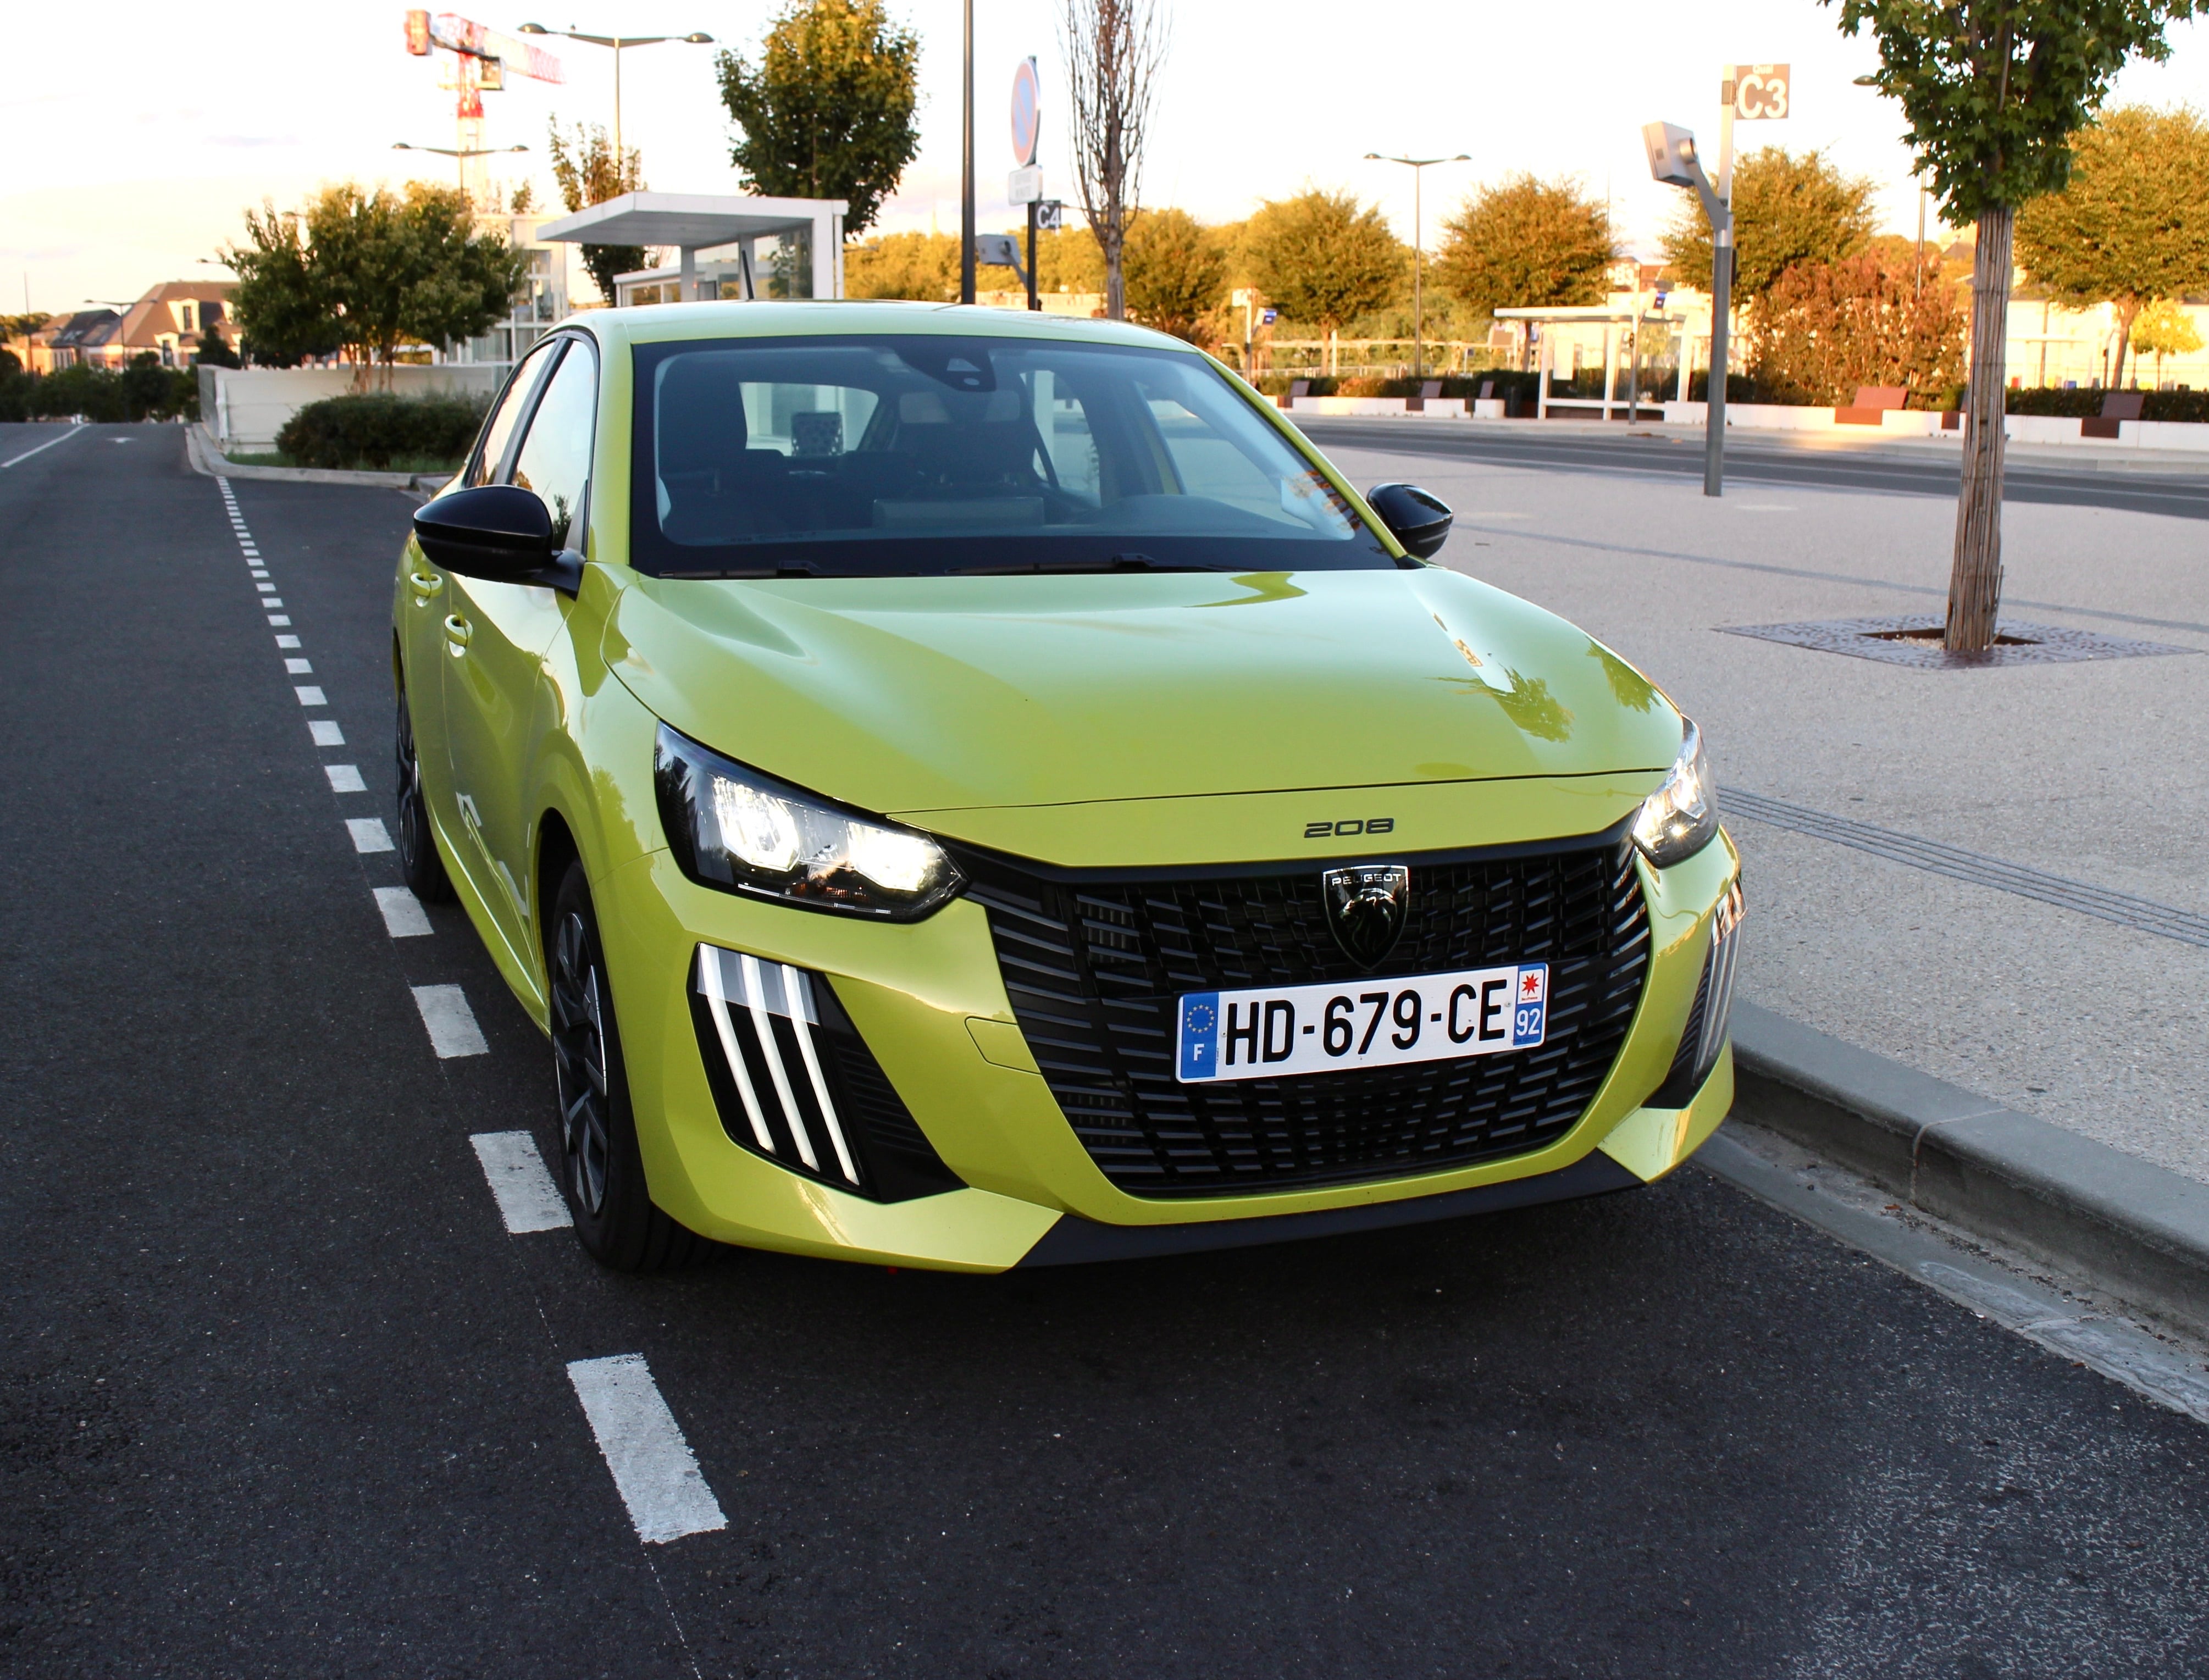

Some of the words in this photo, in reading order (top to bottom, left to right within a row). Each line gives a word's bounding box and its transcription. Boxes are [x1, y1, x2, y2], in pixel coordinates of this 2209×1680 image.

[1738, 74, 1787, 119] C3
[1037, 204, 1060, 229] C4
[1304, 818, 1394, 838] 208
[1332, 873, 1401, 885] PEUGEOT
[1226, 979, 1507, 1065] HD-679-CE
[1516, 1008, 1541, 1036] 92
[1193, 1043, 1205, 1061] F
